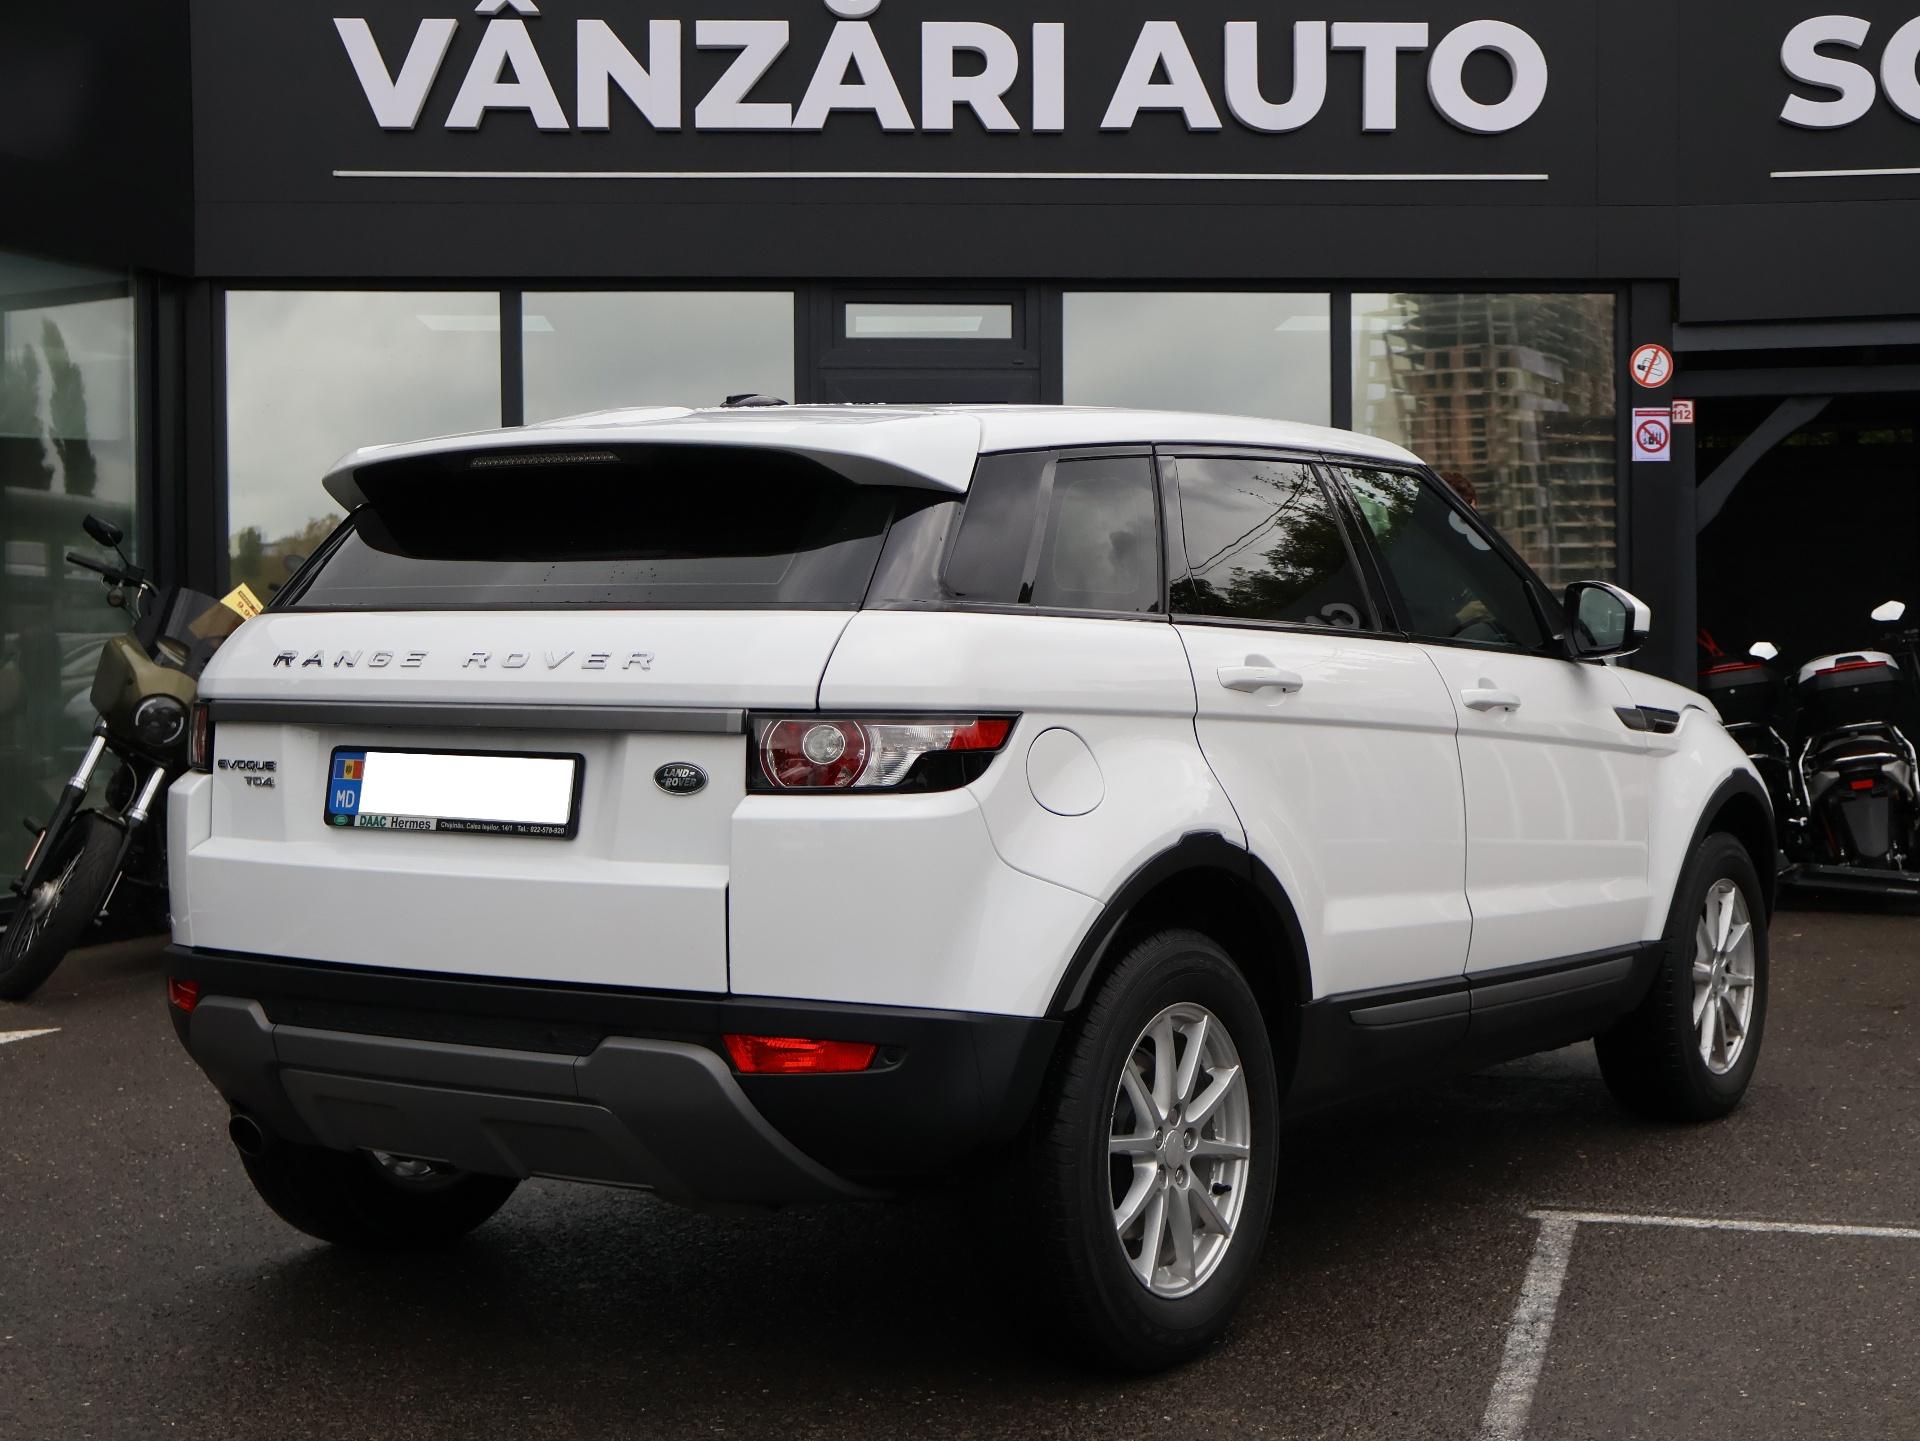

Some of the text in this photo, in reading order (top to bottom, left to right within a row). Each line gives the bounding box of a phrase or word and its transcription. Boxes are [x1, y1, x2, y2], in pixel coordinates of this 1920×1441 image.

[1099, 19, 1549, 134] AUTO
[1672, 410, 1691, 420] 112
[272, 650, 656, 671] RANGE ROVER
[217, 759, 276, 771] EVOQUE
[244, 776, 274, 788] TD4
[335, 789, 355, 808] MD
[359, 815, 387, 828] DAAC
[390, 816, 431, 830] Hermes
